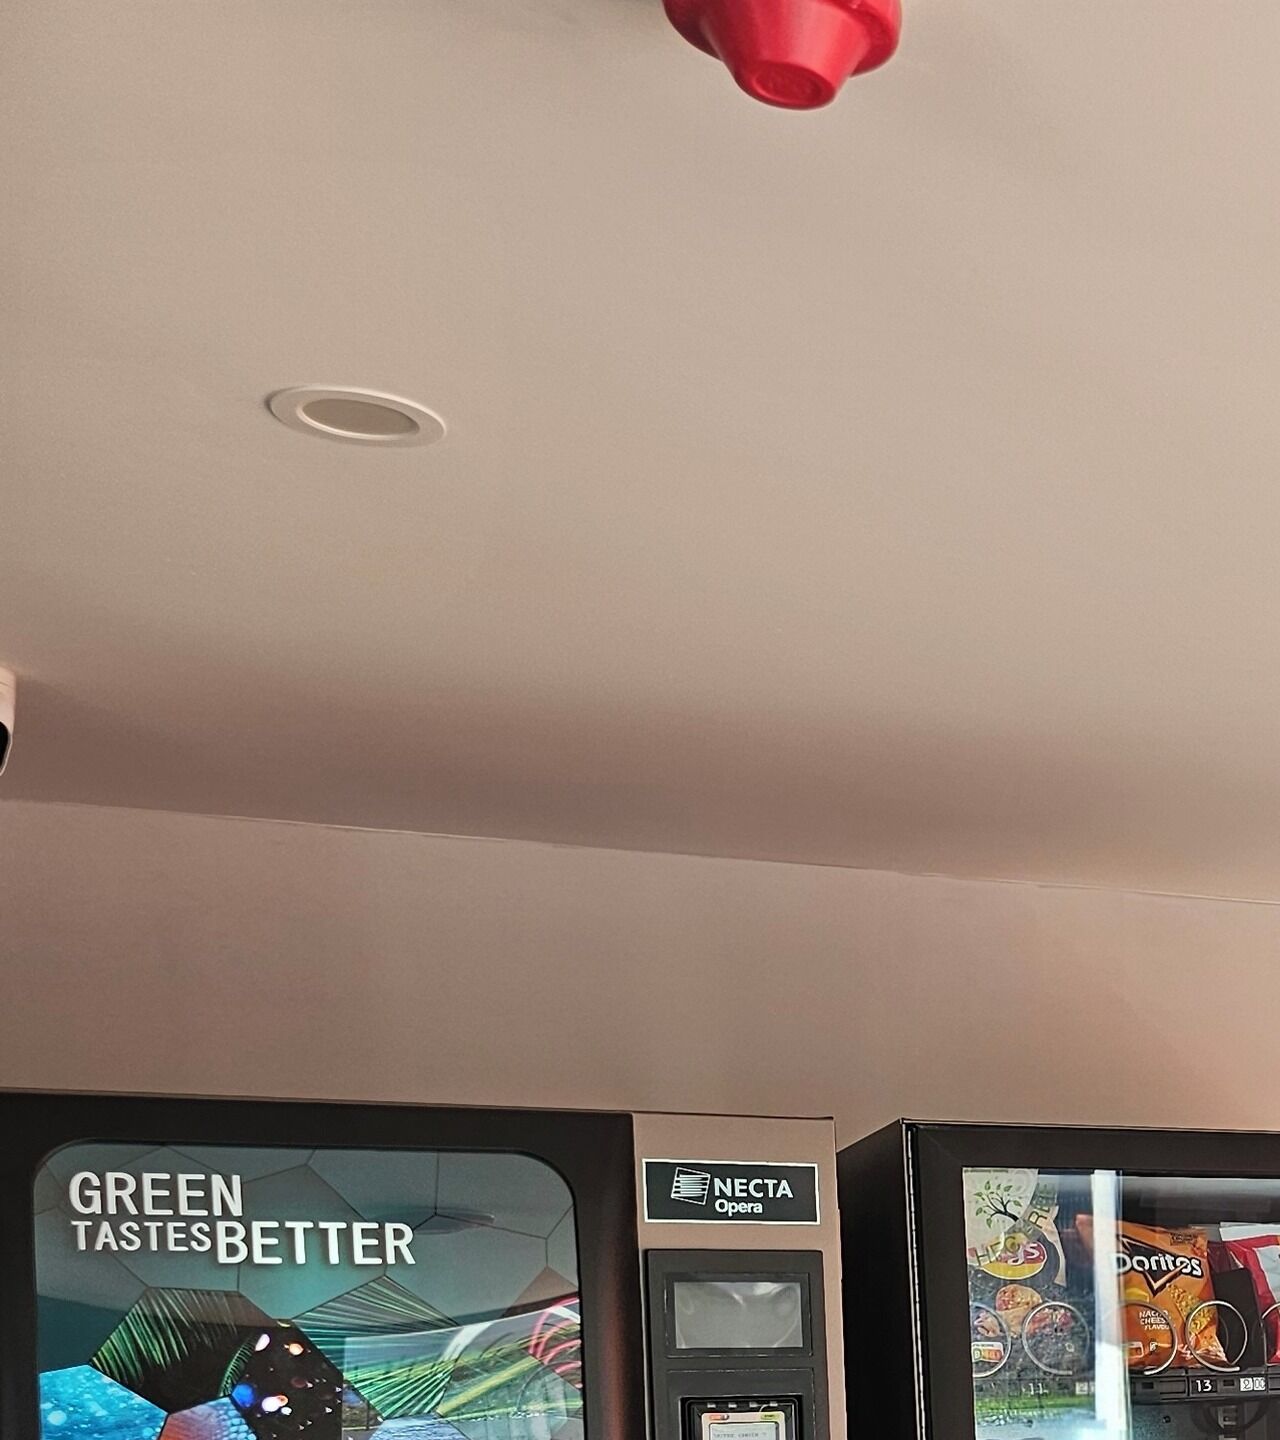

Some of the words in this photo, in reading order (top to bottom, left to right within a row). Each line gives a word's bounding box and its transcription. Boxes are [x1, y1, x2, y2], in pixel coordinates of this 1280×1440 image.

[69, 1171, 243, 1217] GREEN
[714, 1177, 794, 1198] NECTA
[714, 1199, 763, 1217] Opera
[70, 1220, 212, 1252] TASTES
[217, 1220, 416, 1265] BETTER
[1113, 1253, 1203, 1278] Doritos
[1196, 1379, 1212, 1393] 13
